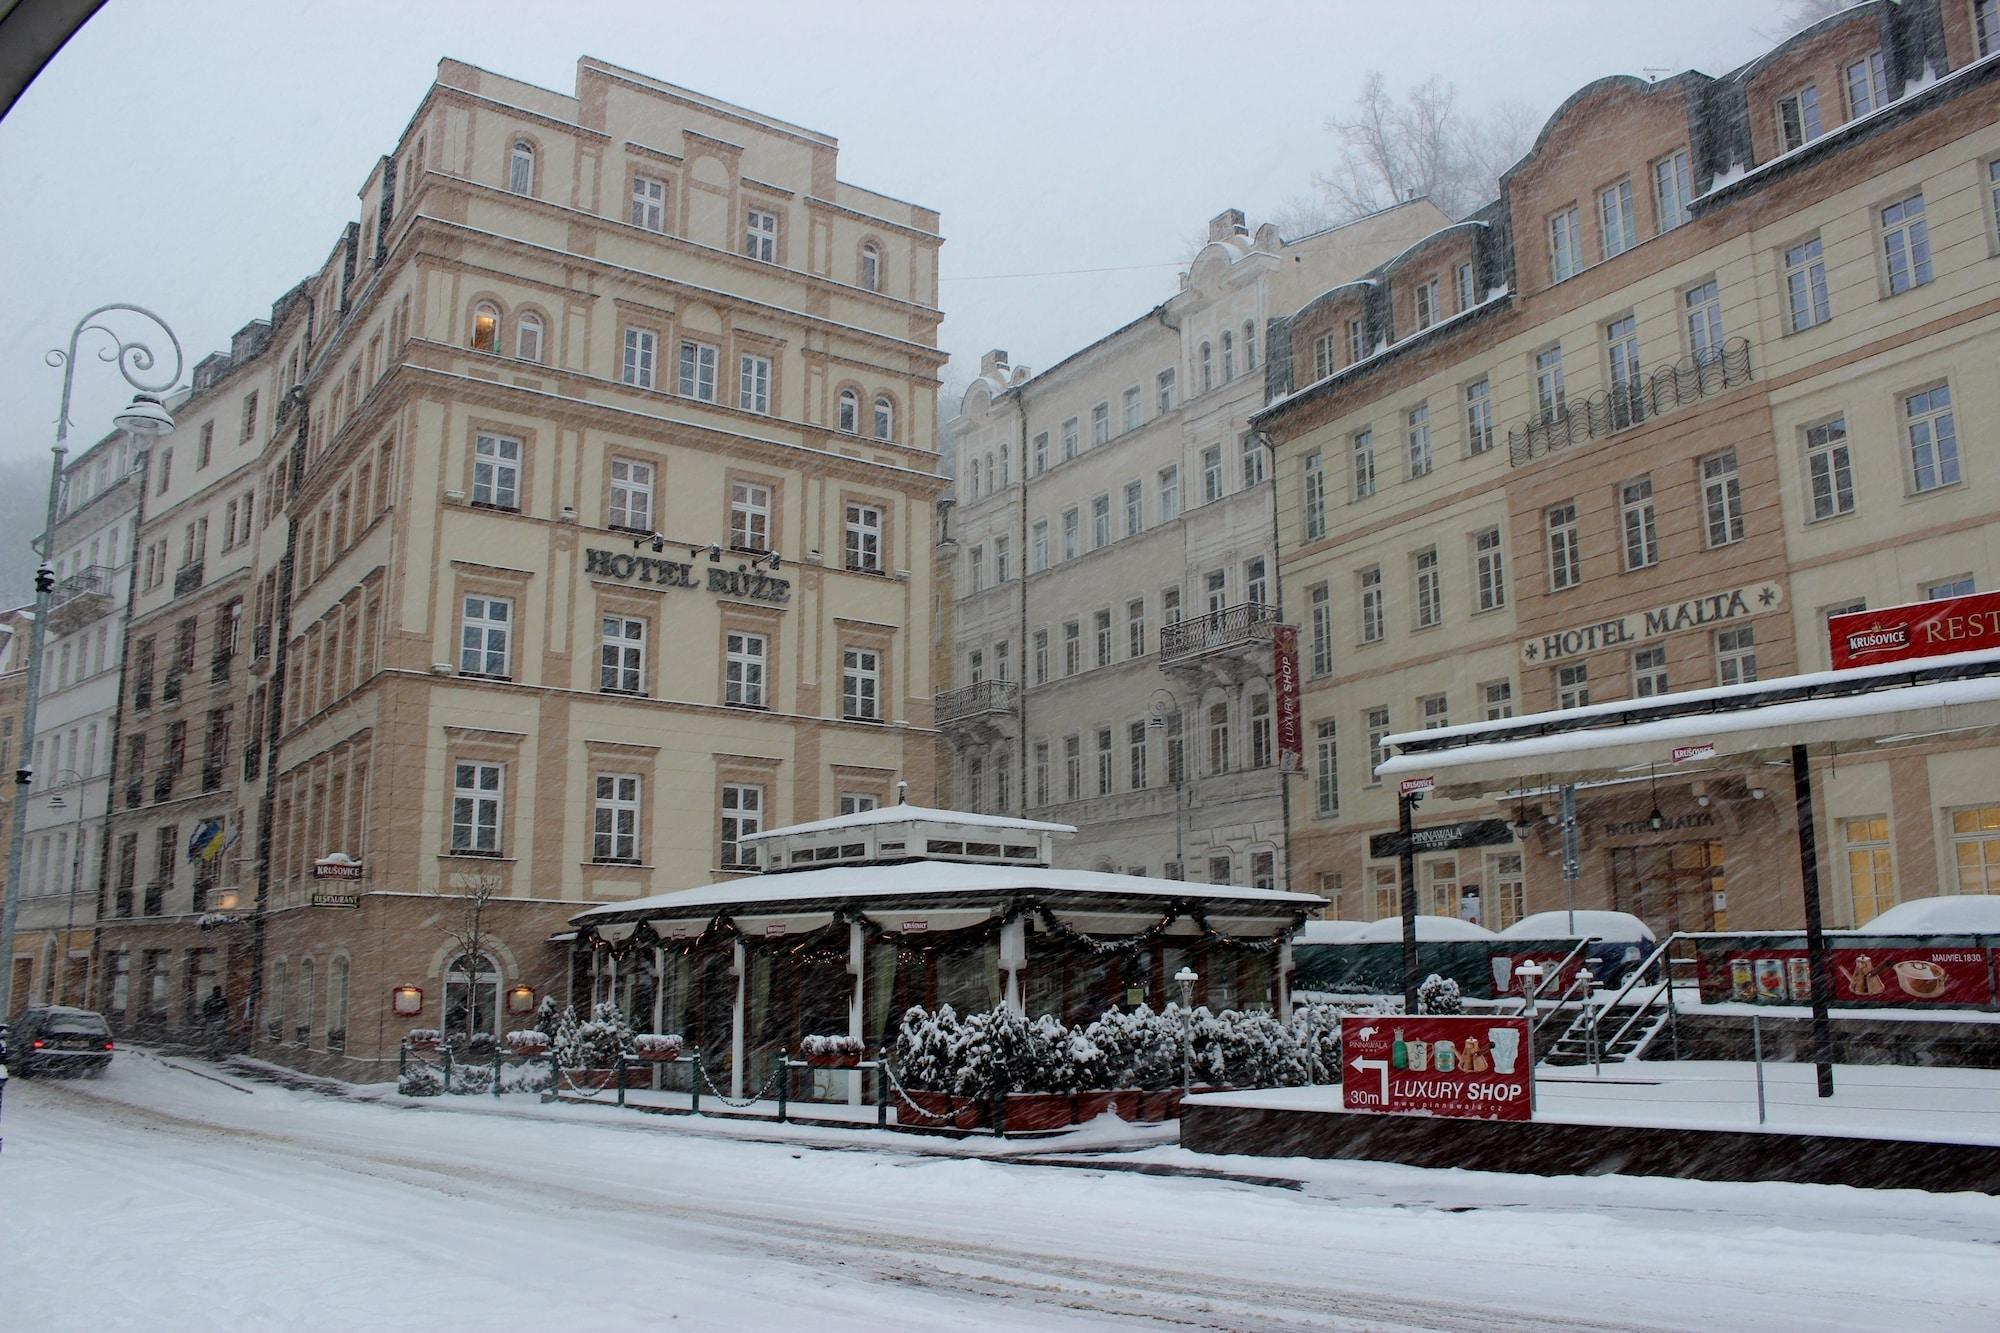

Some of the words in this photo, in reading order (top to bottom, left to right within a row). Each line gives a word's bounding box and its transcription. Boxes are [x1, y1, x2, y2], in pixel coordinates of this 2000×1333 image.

[585, 548, 700, 590] HOTEL
[706, 564, 792, 603] RŮŽE
[1542, 618, 1635, 660] HOTEL
[1644, 589, 1750, 637] MALTA
[1850, 631, 1906, 650] KRUŠOVICE
[1282, 656, 1293, 693] SHOP
[1283, 696, 1295, 743] LUXURY
[1412, 828, 1463, 843] PINNAWALA
[314, 895, 358, 904] RESTAURANT
[1349, 1041, 1388, 1049] PINNAWALA
[1350, 1090, 1379, 1105] 30m
[1394, 1080, 1464, 1099] LUXURY
[1467, 1082, 1522, 1101] SHOP
[1393, 1101, 1503, 1112] www.pinnawala.cz
